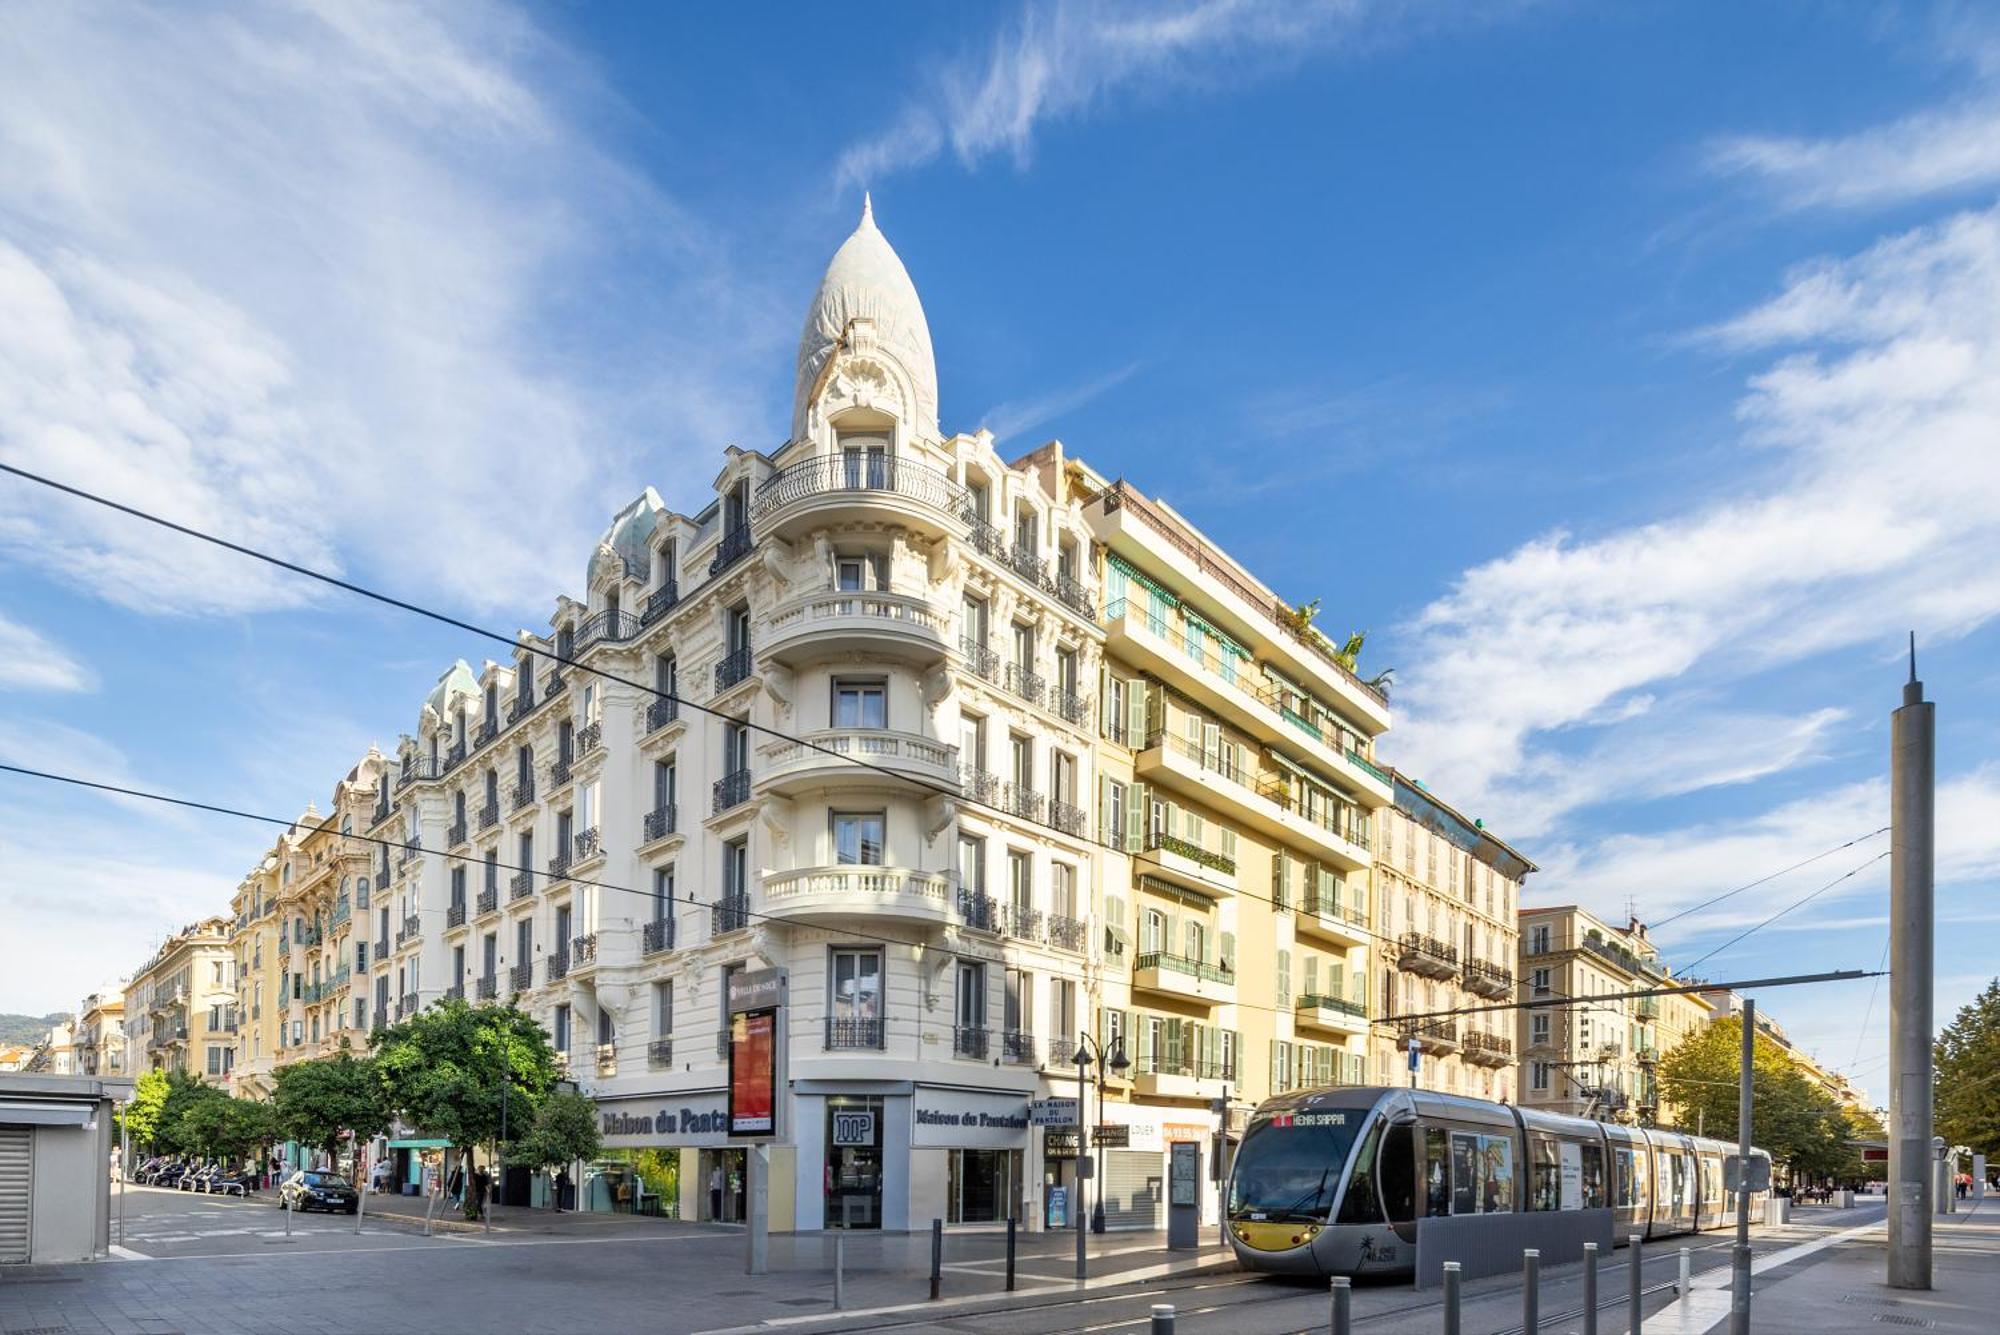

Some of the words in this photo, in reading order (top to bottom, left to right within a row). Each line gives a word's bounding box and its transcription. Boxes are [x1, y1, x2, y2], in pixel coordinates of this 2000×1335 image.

[603, 1112, 653, 1134] Maison
[655, 1109, 677, 1133] du
[680, 1107, 728, 1133] Panta
[916, 1109, 960, 1125] Maison
[961, 1112, 978, 1126] du
[979, 1112, 1028, 1129] Pantalon
[1293, 1114, 1316, 1127] HENRI
[1317, 1114, 1345, 1126] SAPPIA
[1048, 1135, 1080, 1147] CHANG
